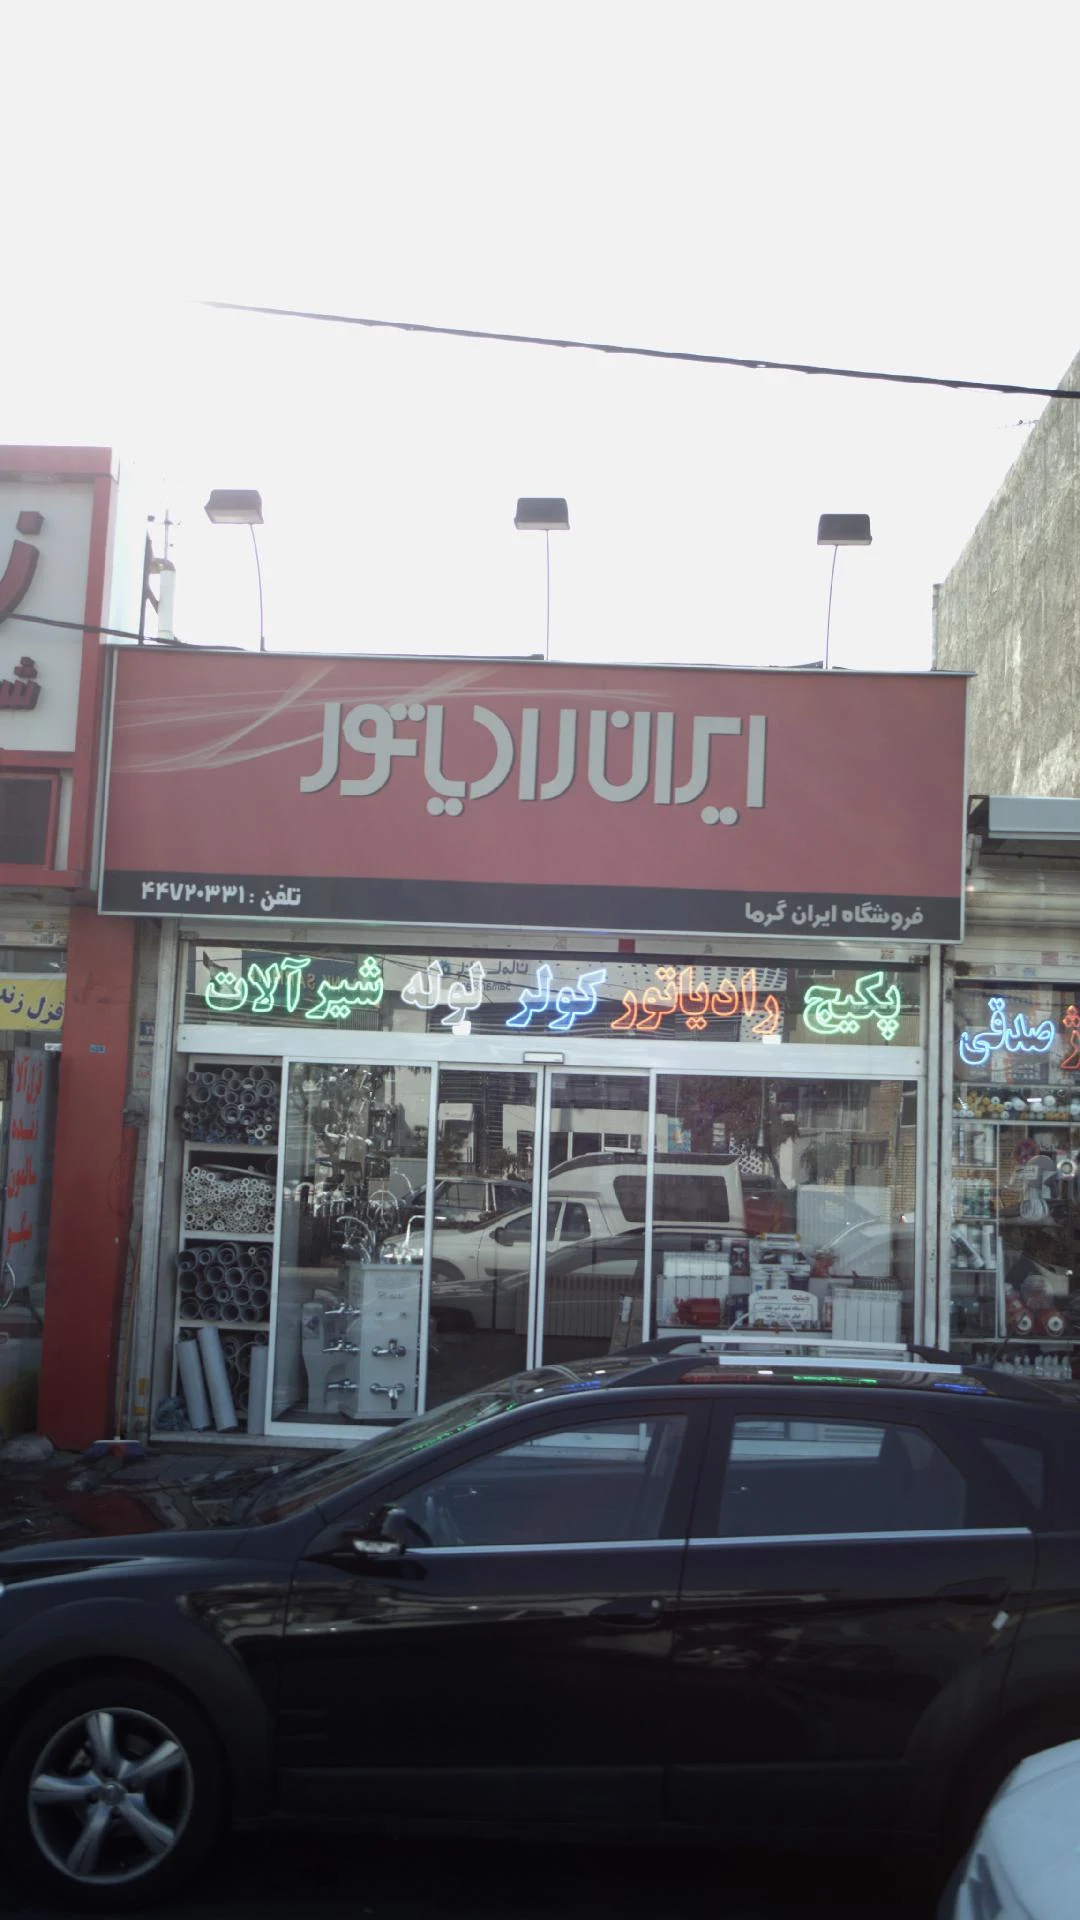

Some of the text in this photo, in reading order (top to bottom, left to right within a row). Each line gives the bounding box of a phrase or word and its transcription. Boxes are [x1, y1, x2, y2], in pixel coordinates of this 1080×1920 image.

[300, 702, 767, 826] ایران رادیاتور
[141, 881, 245, 904] ۴۴۷۲۰۳۳۱
[745, 899, 924, 931] فروشگاه ایران گرما
[305, 956, 384, 1019] شیر
[400, 959, 486, 1026] لوله
[506, 964, 608, 1031] کولر
[611, 965, 781, 1035] رادیاتور
[803, 971, 901, 1041] پکیج
